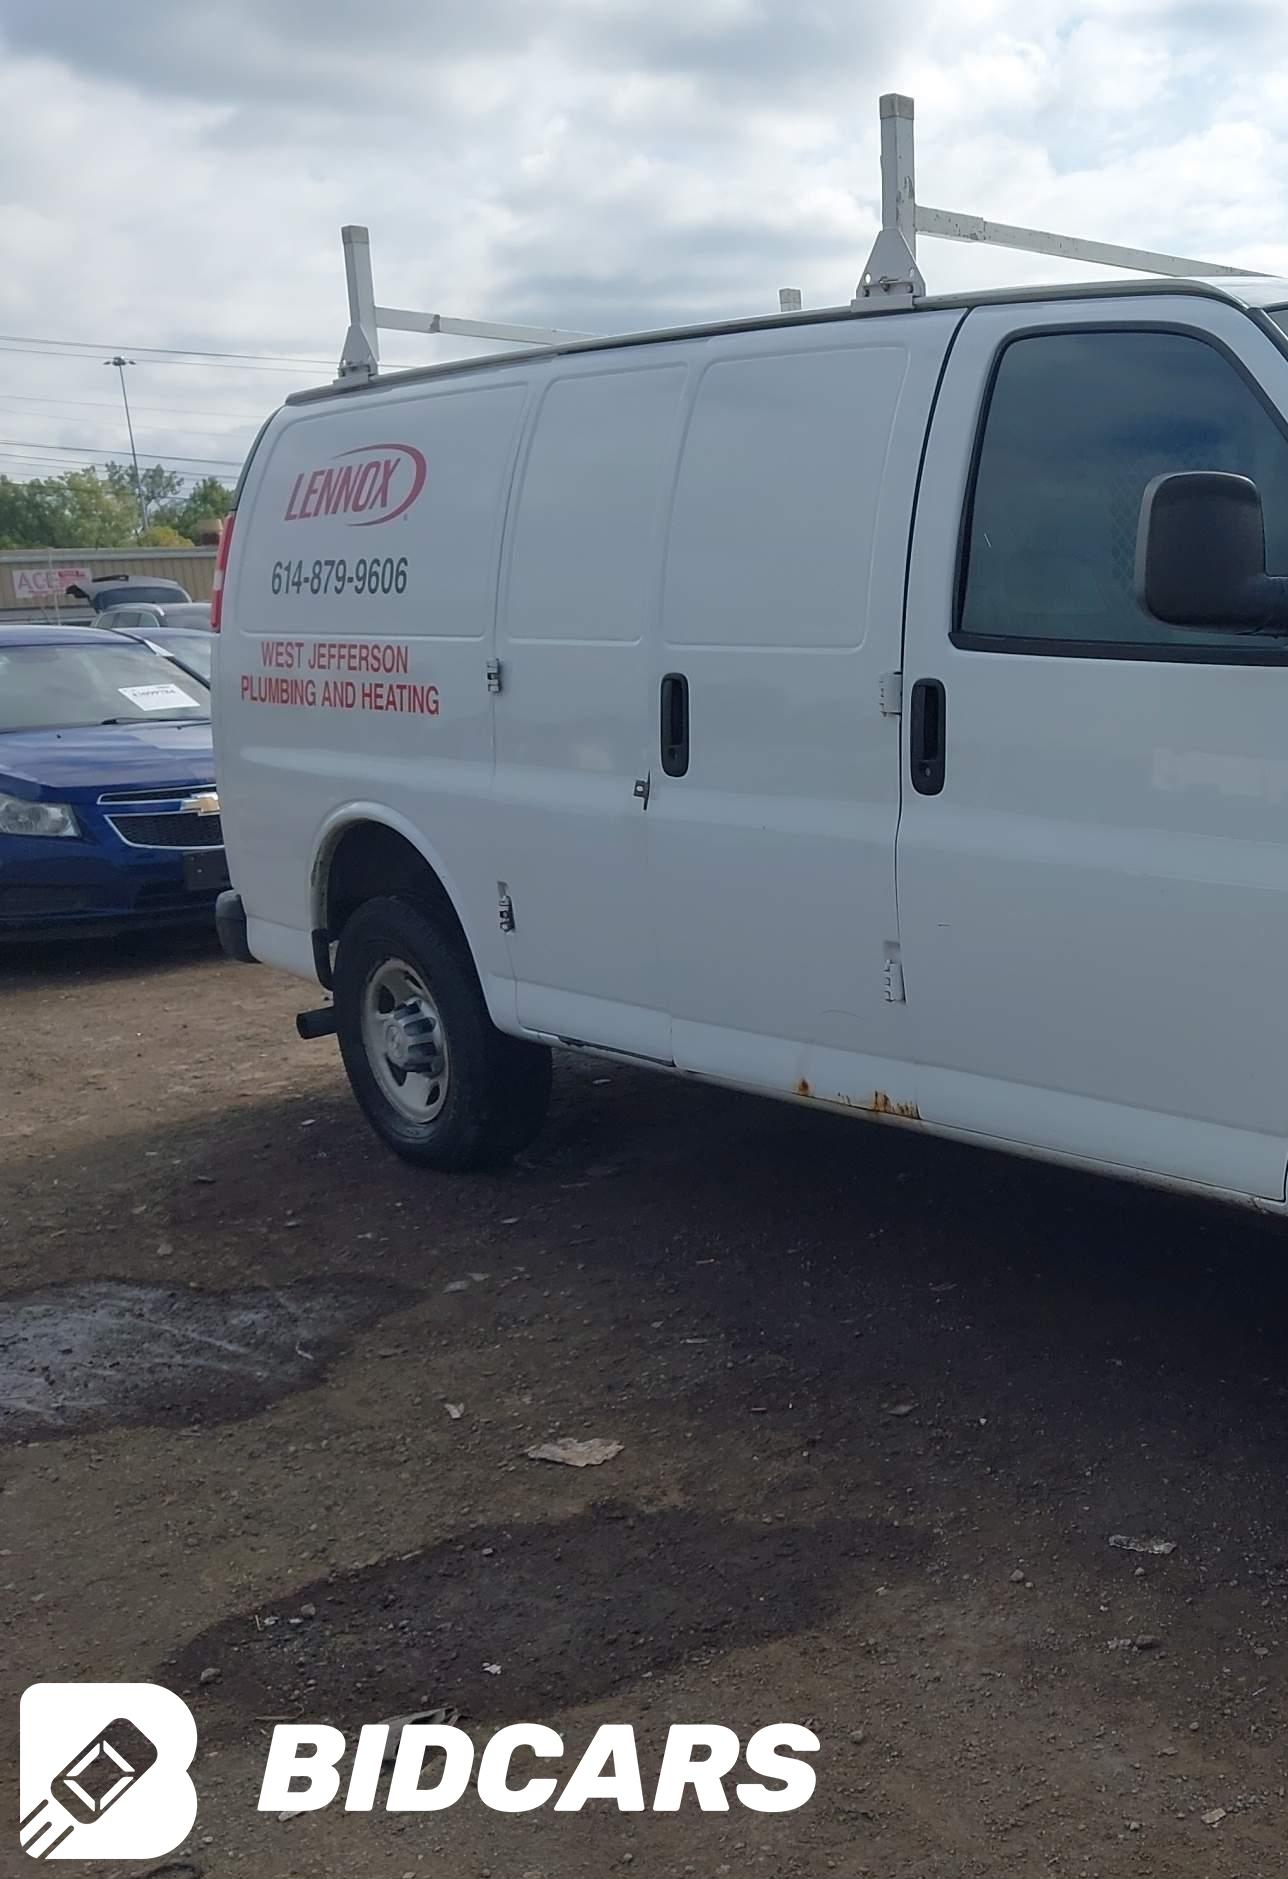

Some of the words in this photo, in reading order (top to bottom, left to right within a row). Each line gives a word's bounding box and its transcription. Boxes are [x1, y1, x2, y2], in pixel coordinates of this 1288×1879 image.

[284, 458, 401, 521] LENNOX
[271, 557, 409, 594] 614-879-9606
[261, 641, 304, 669] WEST
[308, 643, 409, 674] JEFFERSON
[240, 675, 317, 706] PLUMBING
[321, 680, 356, 708] AND
[361, 683, 440, 715] HEATING
